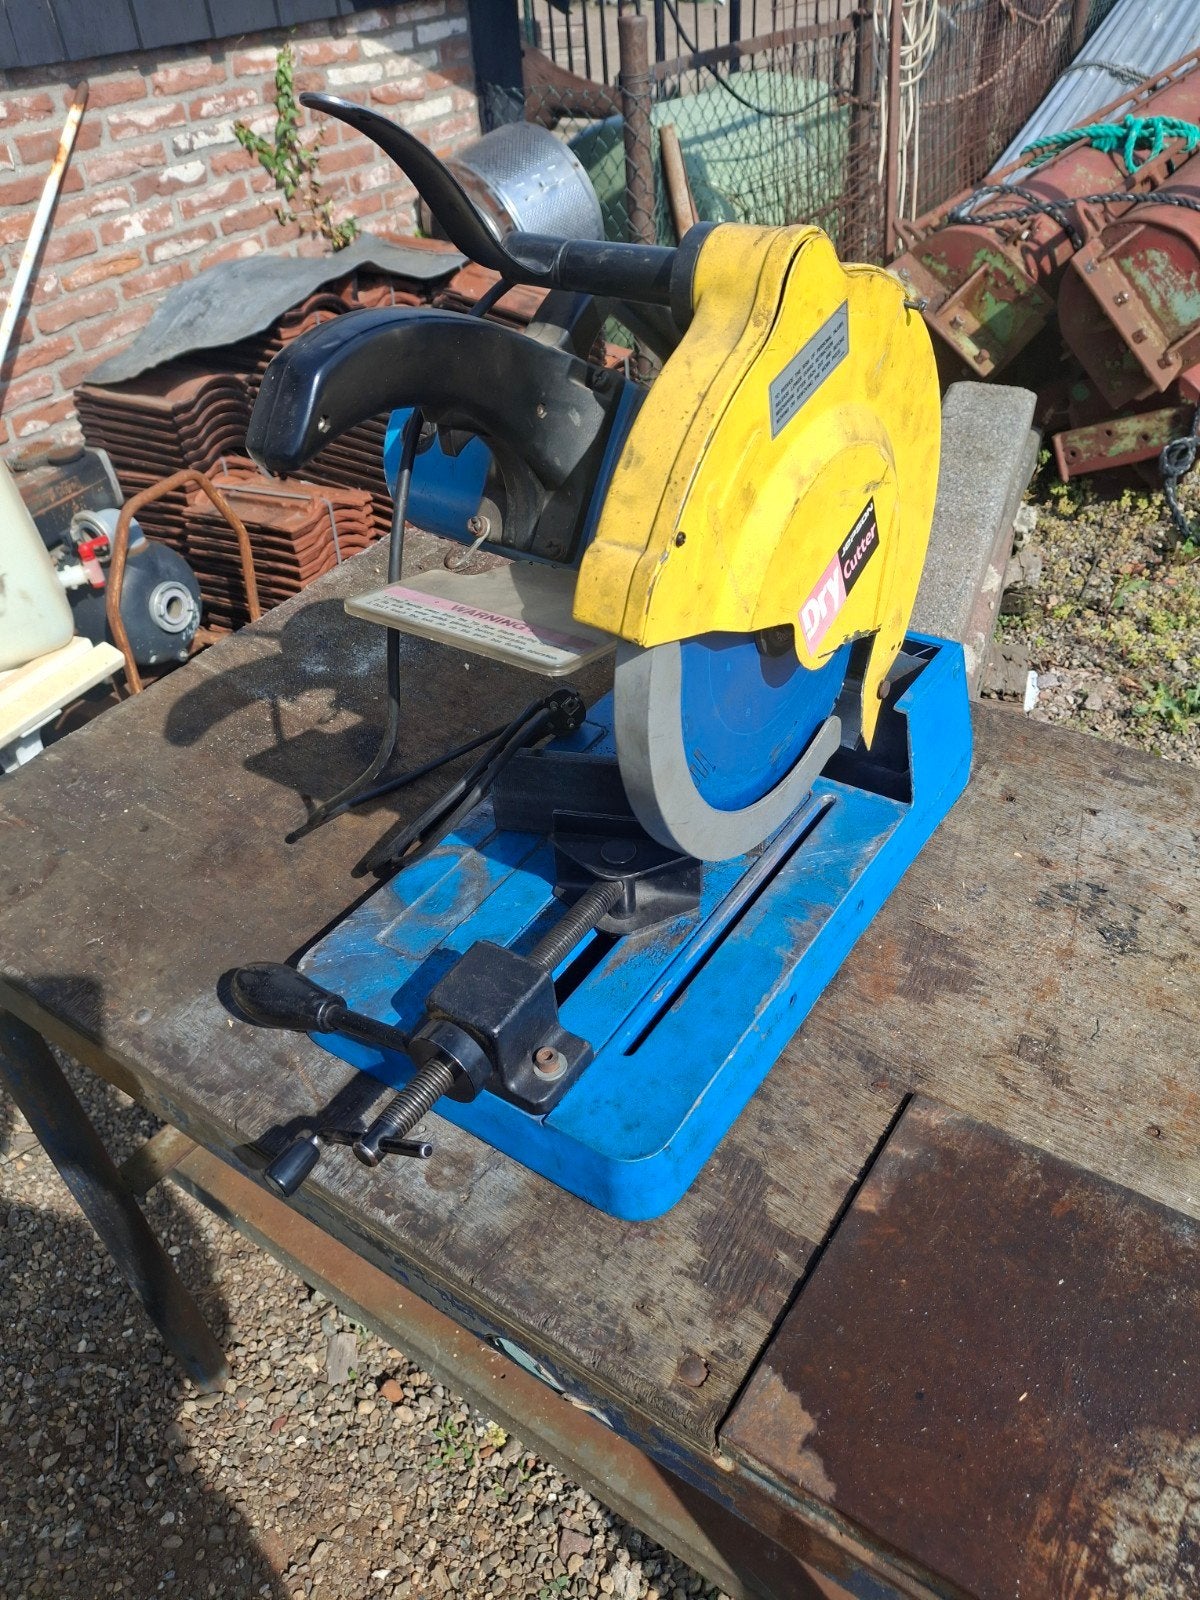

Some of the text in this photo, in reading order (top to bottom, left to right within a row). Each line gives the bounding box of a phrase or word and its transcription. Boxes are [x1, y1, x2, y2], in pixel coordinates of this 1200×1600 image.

[841, 503, 873, 557] JEPSON
[843, 523, 876, 579] Cutter
[451, 604, 526, 631] WARNING
[801, 566, 840, 641] Dry
